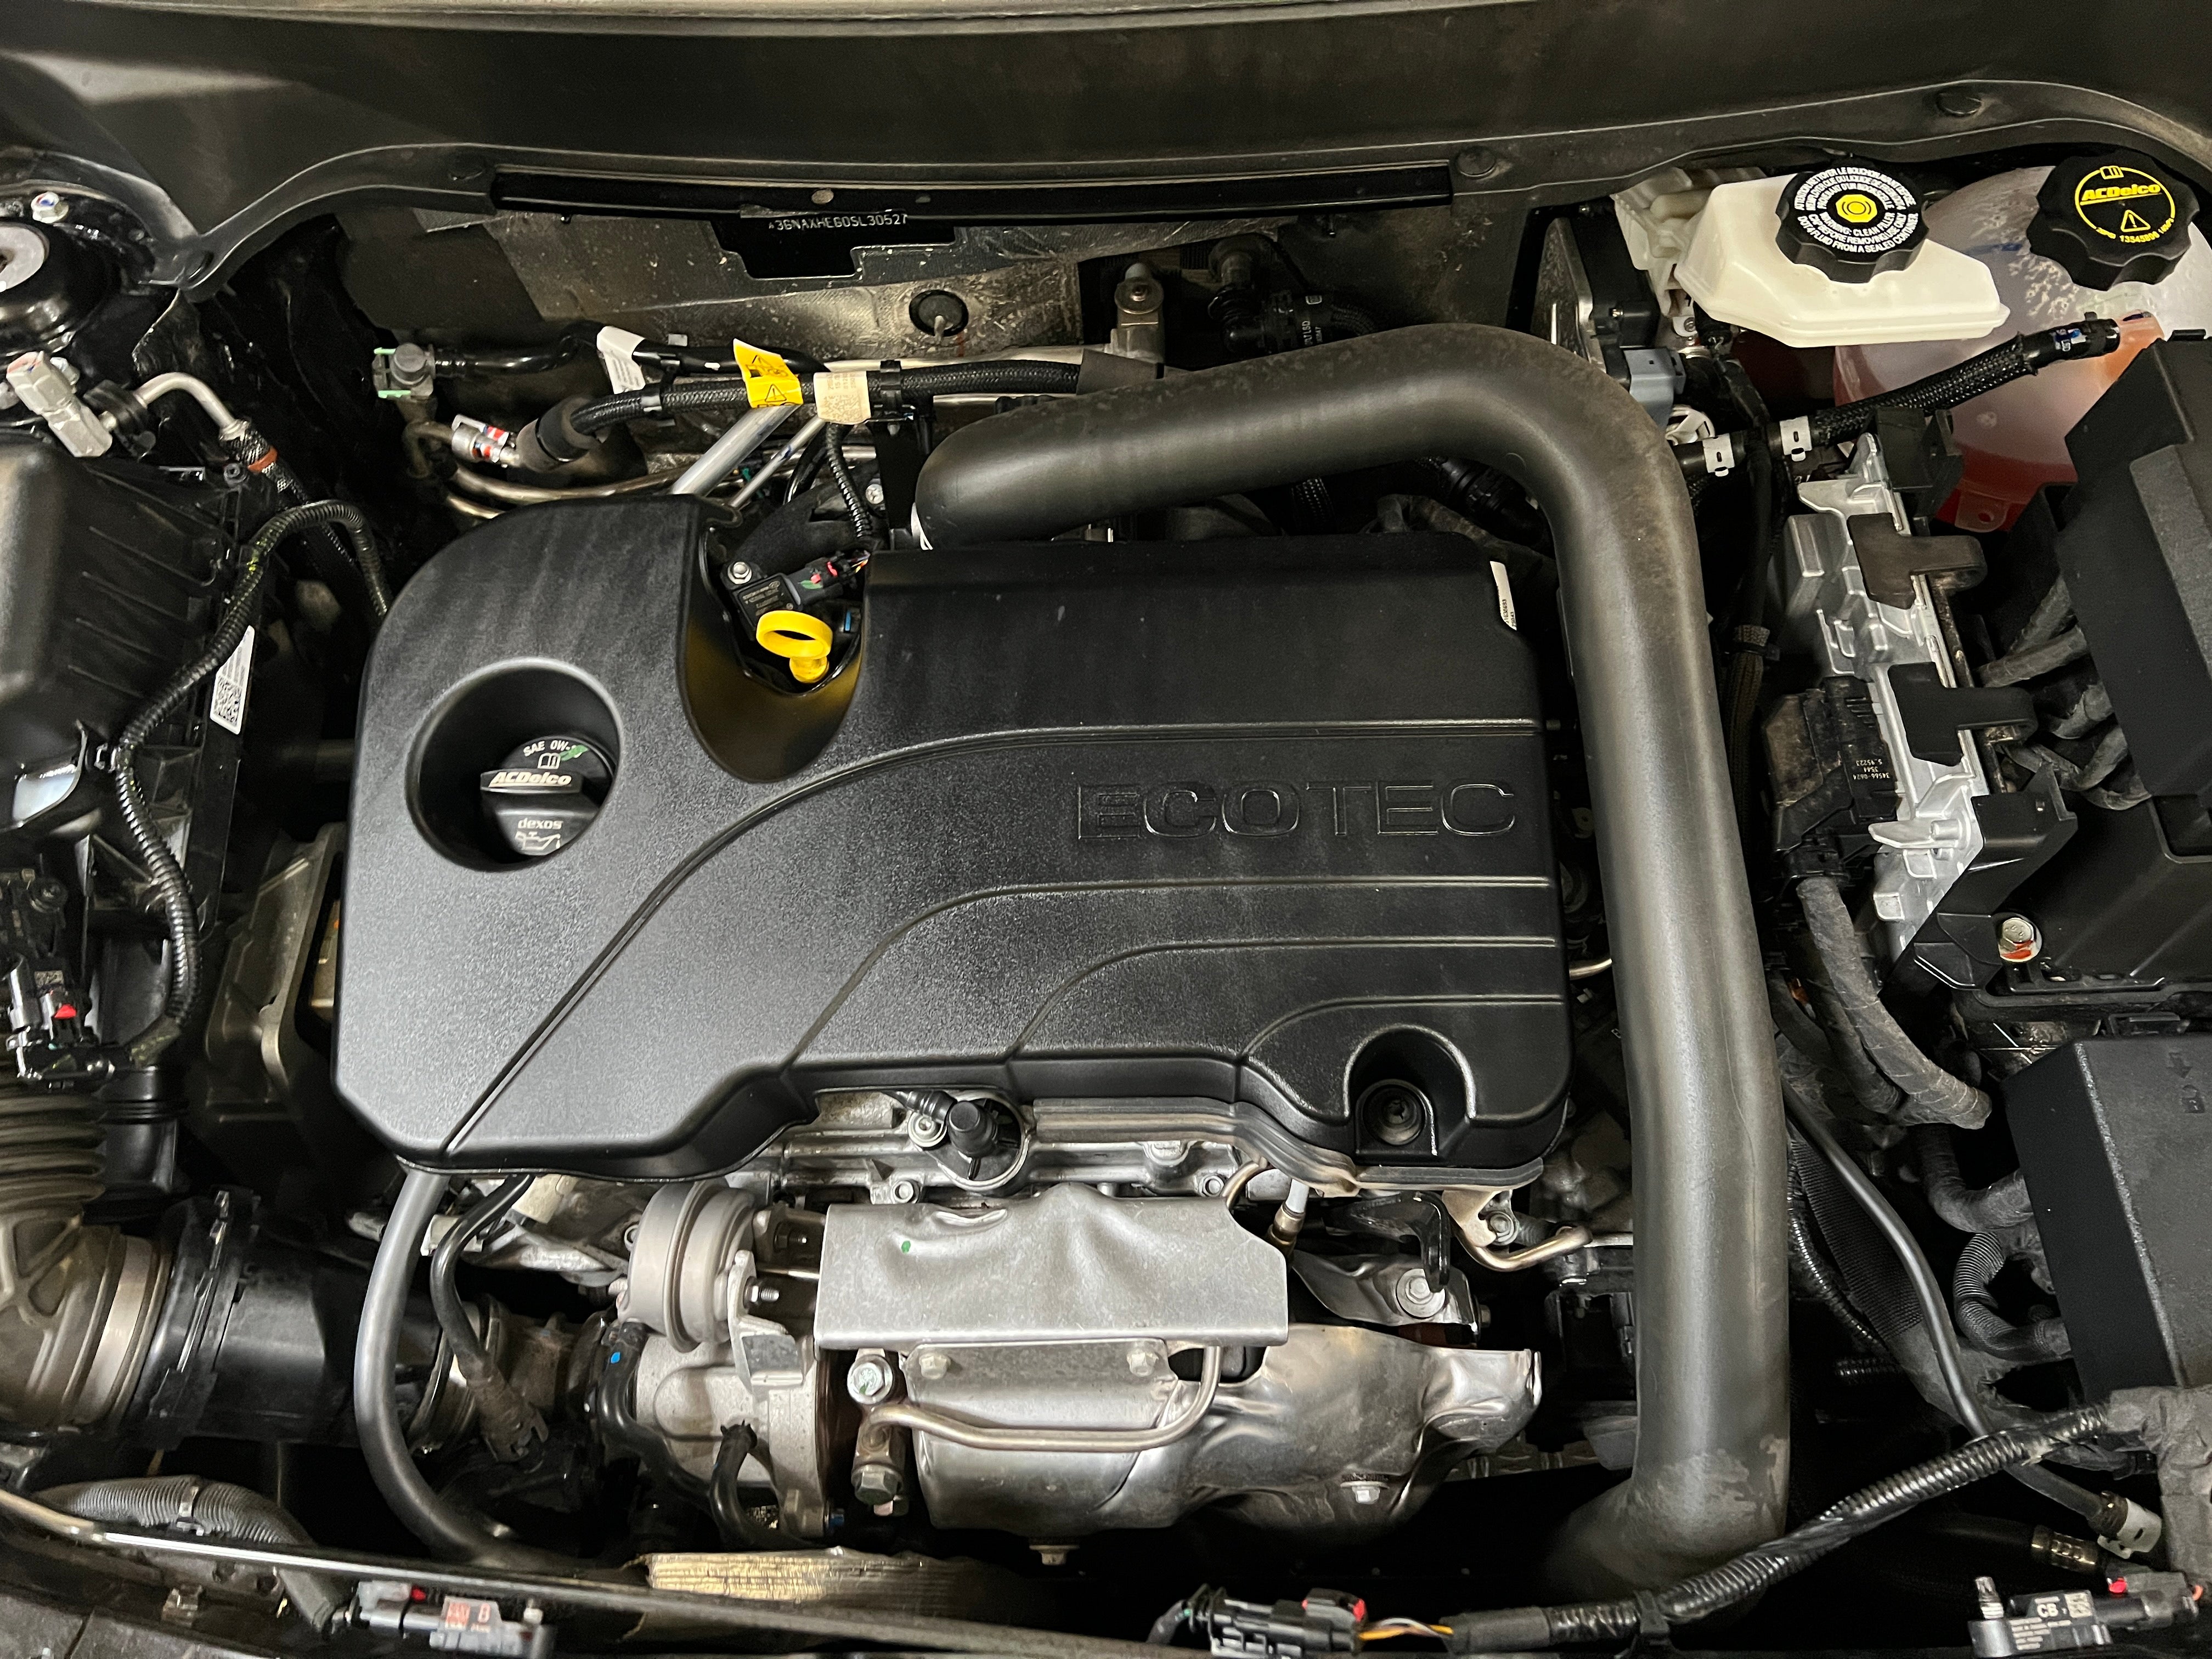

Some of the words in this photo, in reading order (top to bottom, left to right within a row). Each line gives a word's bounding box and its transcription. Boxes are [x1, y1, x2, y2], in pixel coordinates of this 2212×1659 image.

[2081, 184, 2161, 201] ACDelco
[1808, 214, 1824, 225] CAP
[1818, 224, 1848, 242] BEFORE
[1894, 212, 1906, 228] ONLY
[1810, 229, 1833, 245] FLUID
[1832, 241, 1858, 252] FROM
[1864, 240, 1896, 253] SEALED
[1892, 212, 1918, 244] CONTAINER
[1853, 226, 1881, 236] CLEAN
[1877, 212, 1895, 231] FILLER
[523, 741, 545, 757] SAE
[489, 772, 572, 787] ACDelco
[1077, 781, 1515, 839] ECOTEC
[517, 817, 563, 830] dexos
